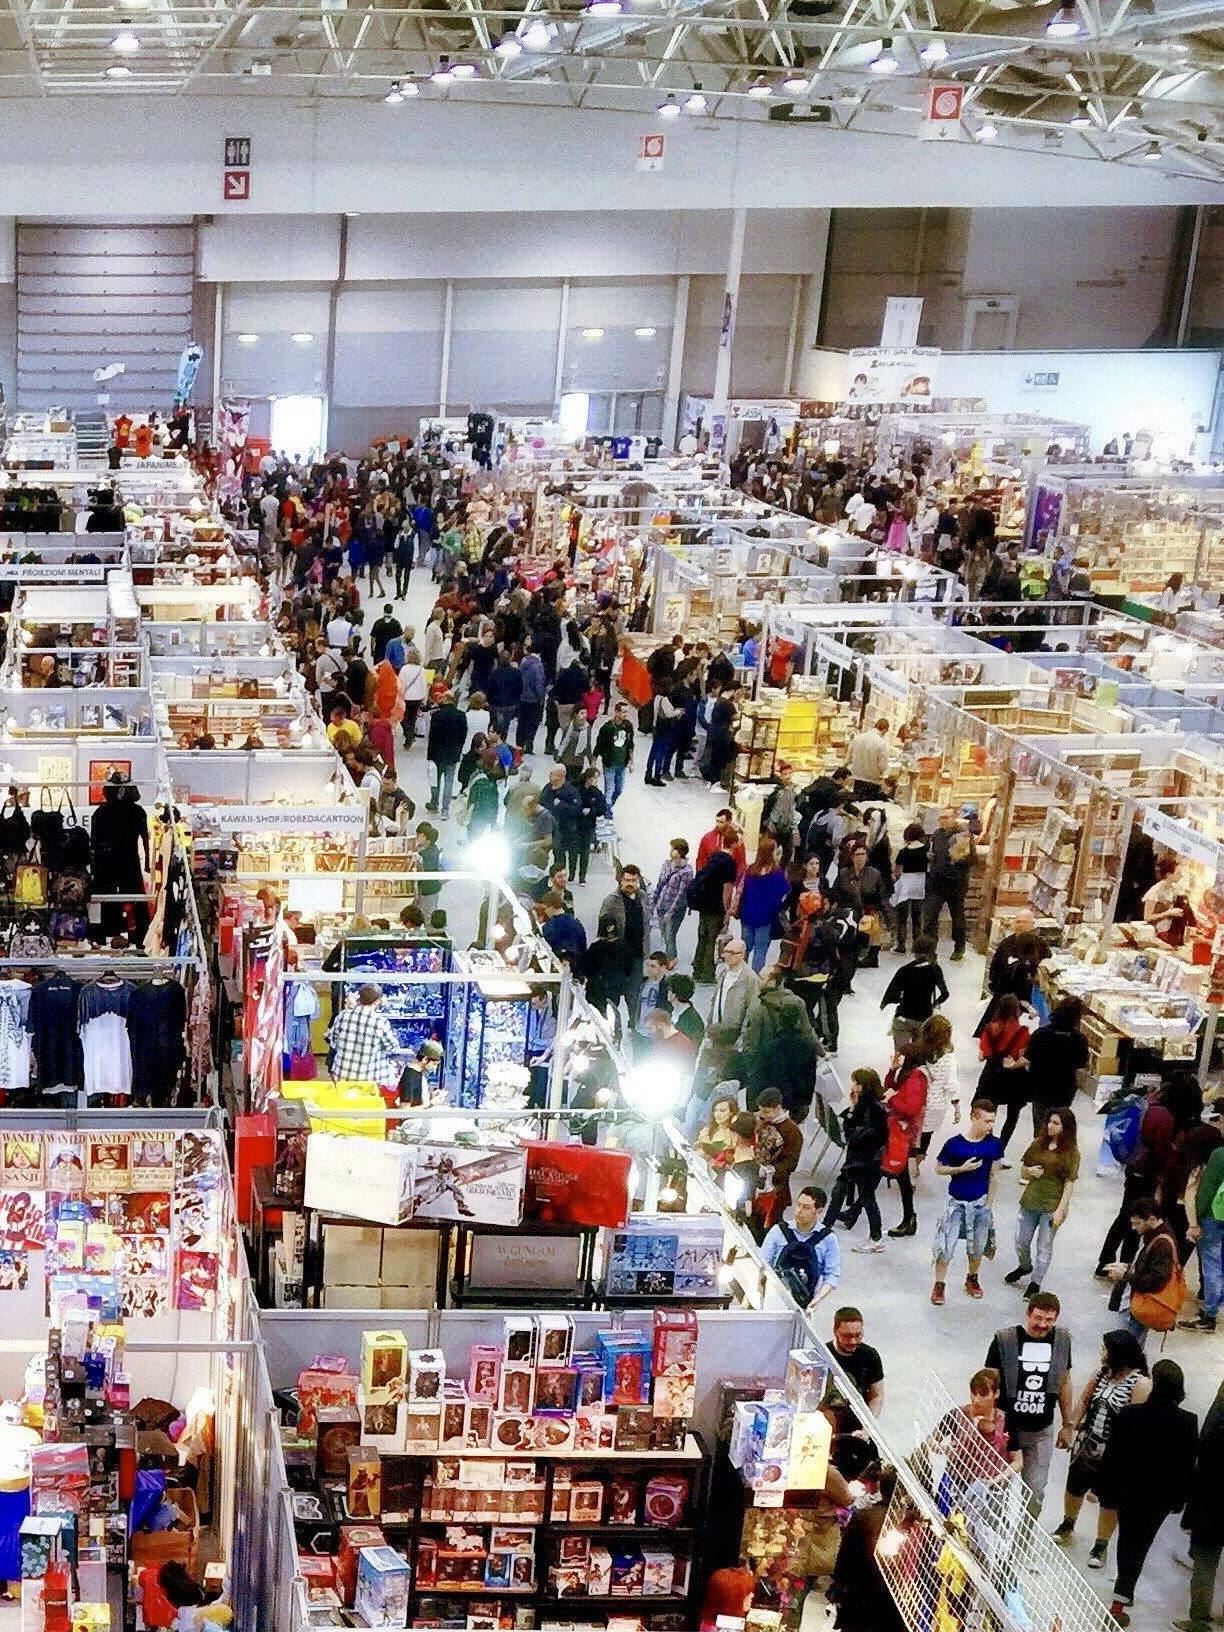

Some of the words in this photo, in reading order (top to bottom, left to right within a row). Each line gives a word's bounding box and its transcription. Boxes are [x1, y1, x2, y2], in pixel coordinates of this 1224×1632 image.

[88, 1133, 130, 1144] WANTED
[133, 1131, 176, 1141] WANTED
[4, 1173, 38, 1182] SANJI
[1017, 1390, 1046, 1403] LET'S
[1013, 1401, 1046, 1414] COOK
